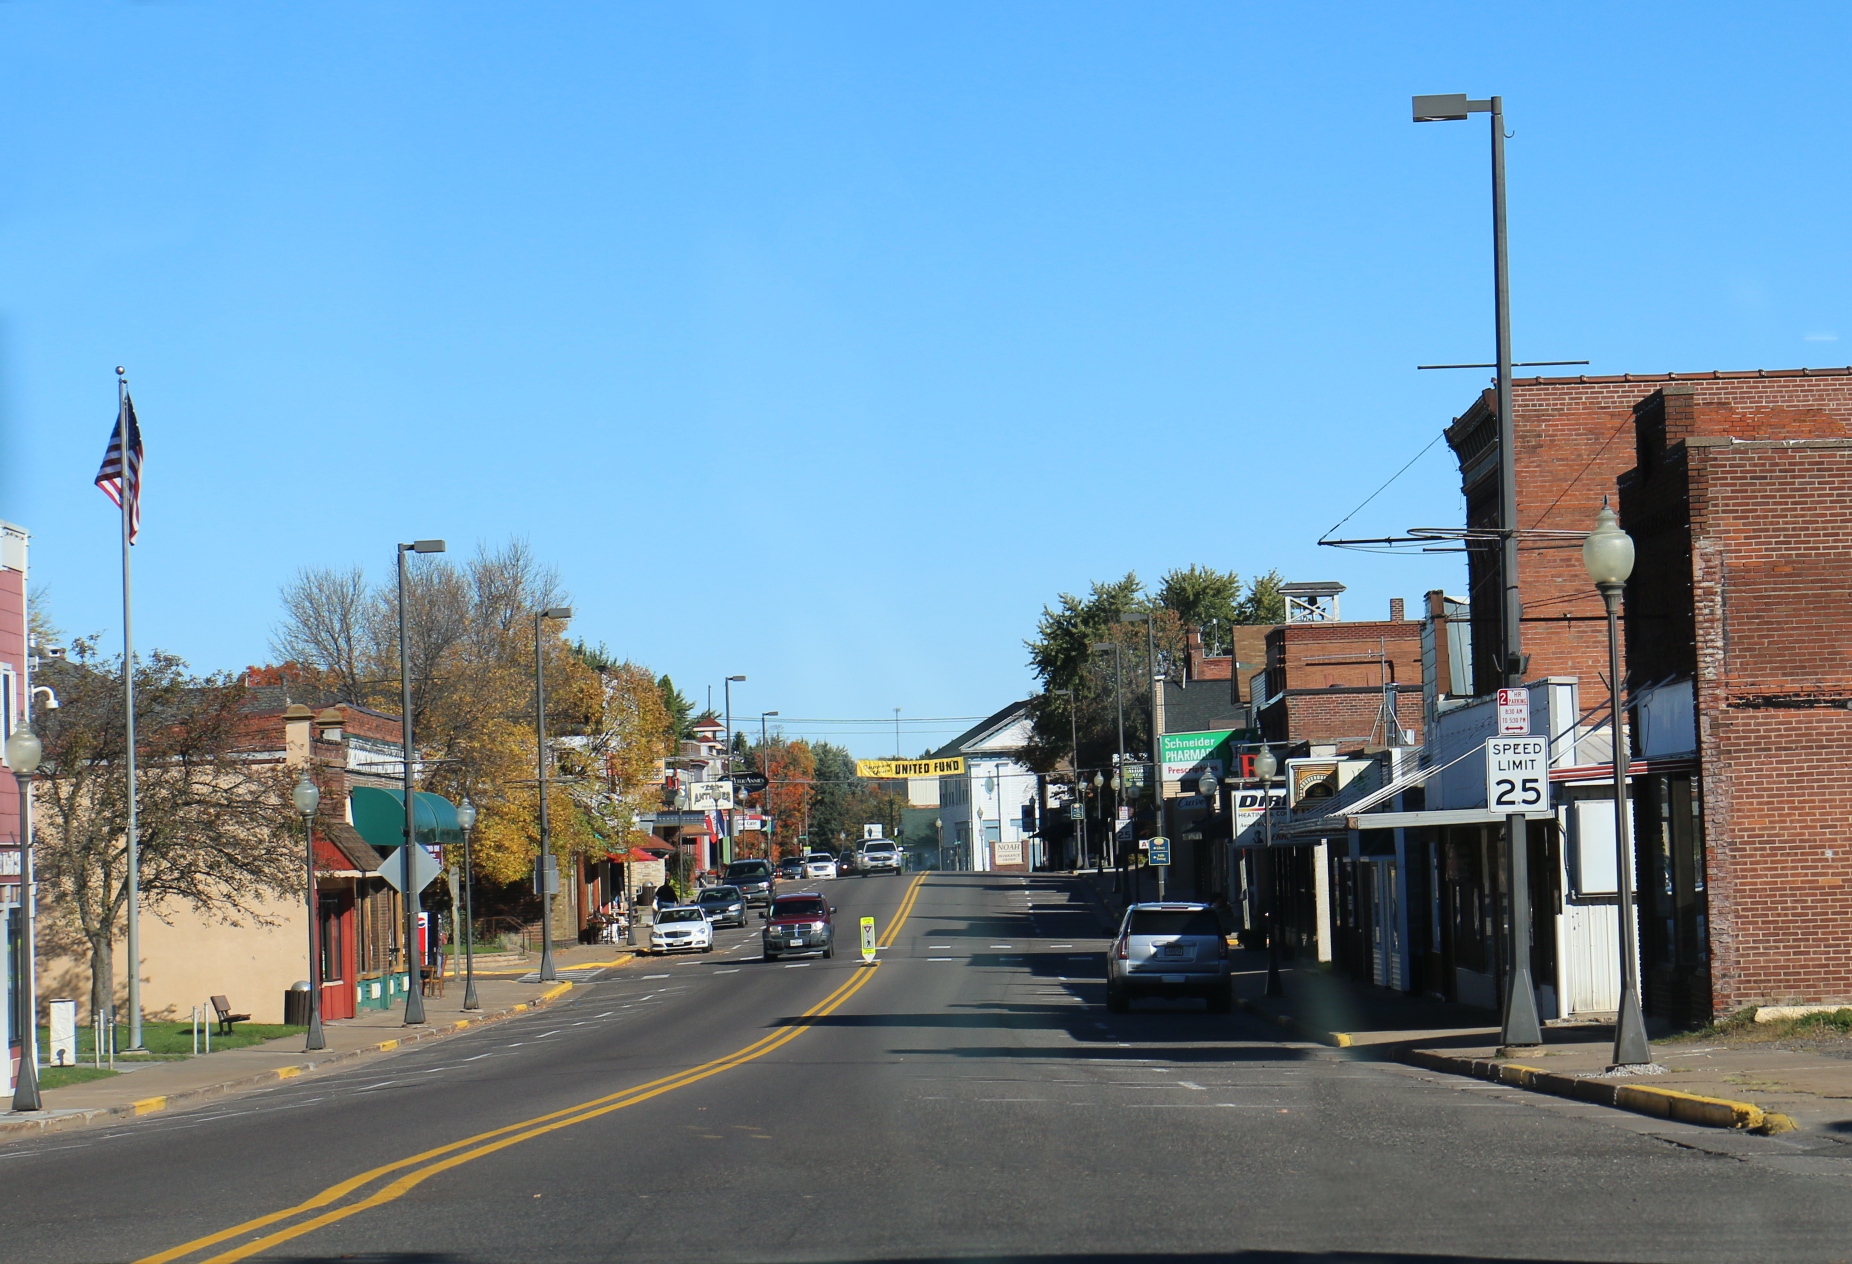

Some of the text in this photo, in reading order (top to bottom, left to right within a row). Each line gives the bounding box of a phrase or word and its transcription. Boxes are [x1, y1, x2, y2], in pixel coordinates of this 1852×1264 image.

[1500, 693, 1507, 704] 2
[1164, 737, 1216, 749] Schneider
[1165, 747, 1218, 762] PHARMACY
[1492, 743, 1542, 755] SPEED
[895, 760, 959, 775] UNITED FUND
[1167, 764, 1219, 775] Prescriptins
[1498, 760, 1537, 771] LIMIT
[1495, 779, 1542, 806] 25
[1118, 830, 1131, 839] 25
[997, 843, 1020, 851] NOAH
